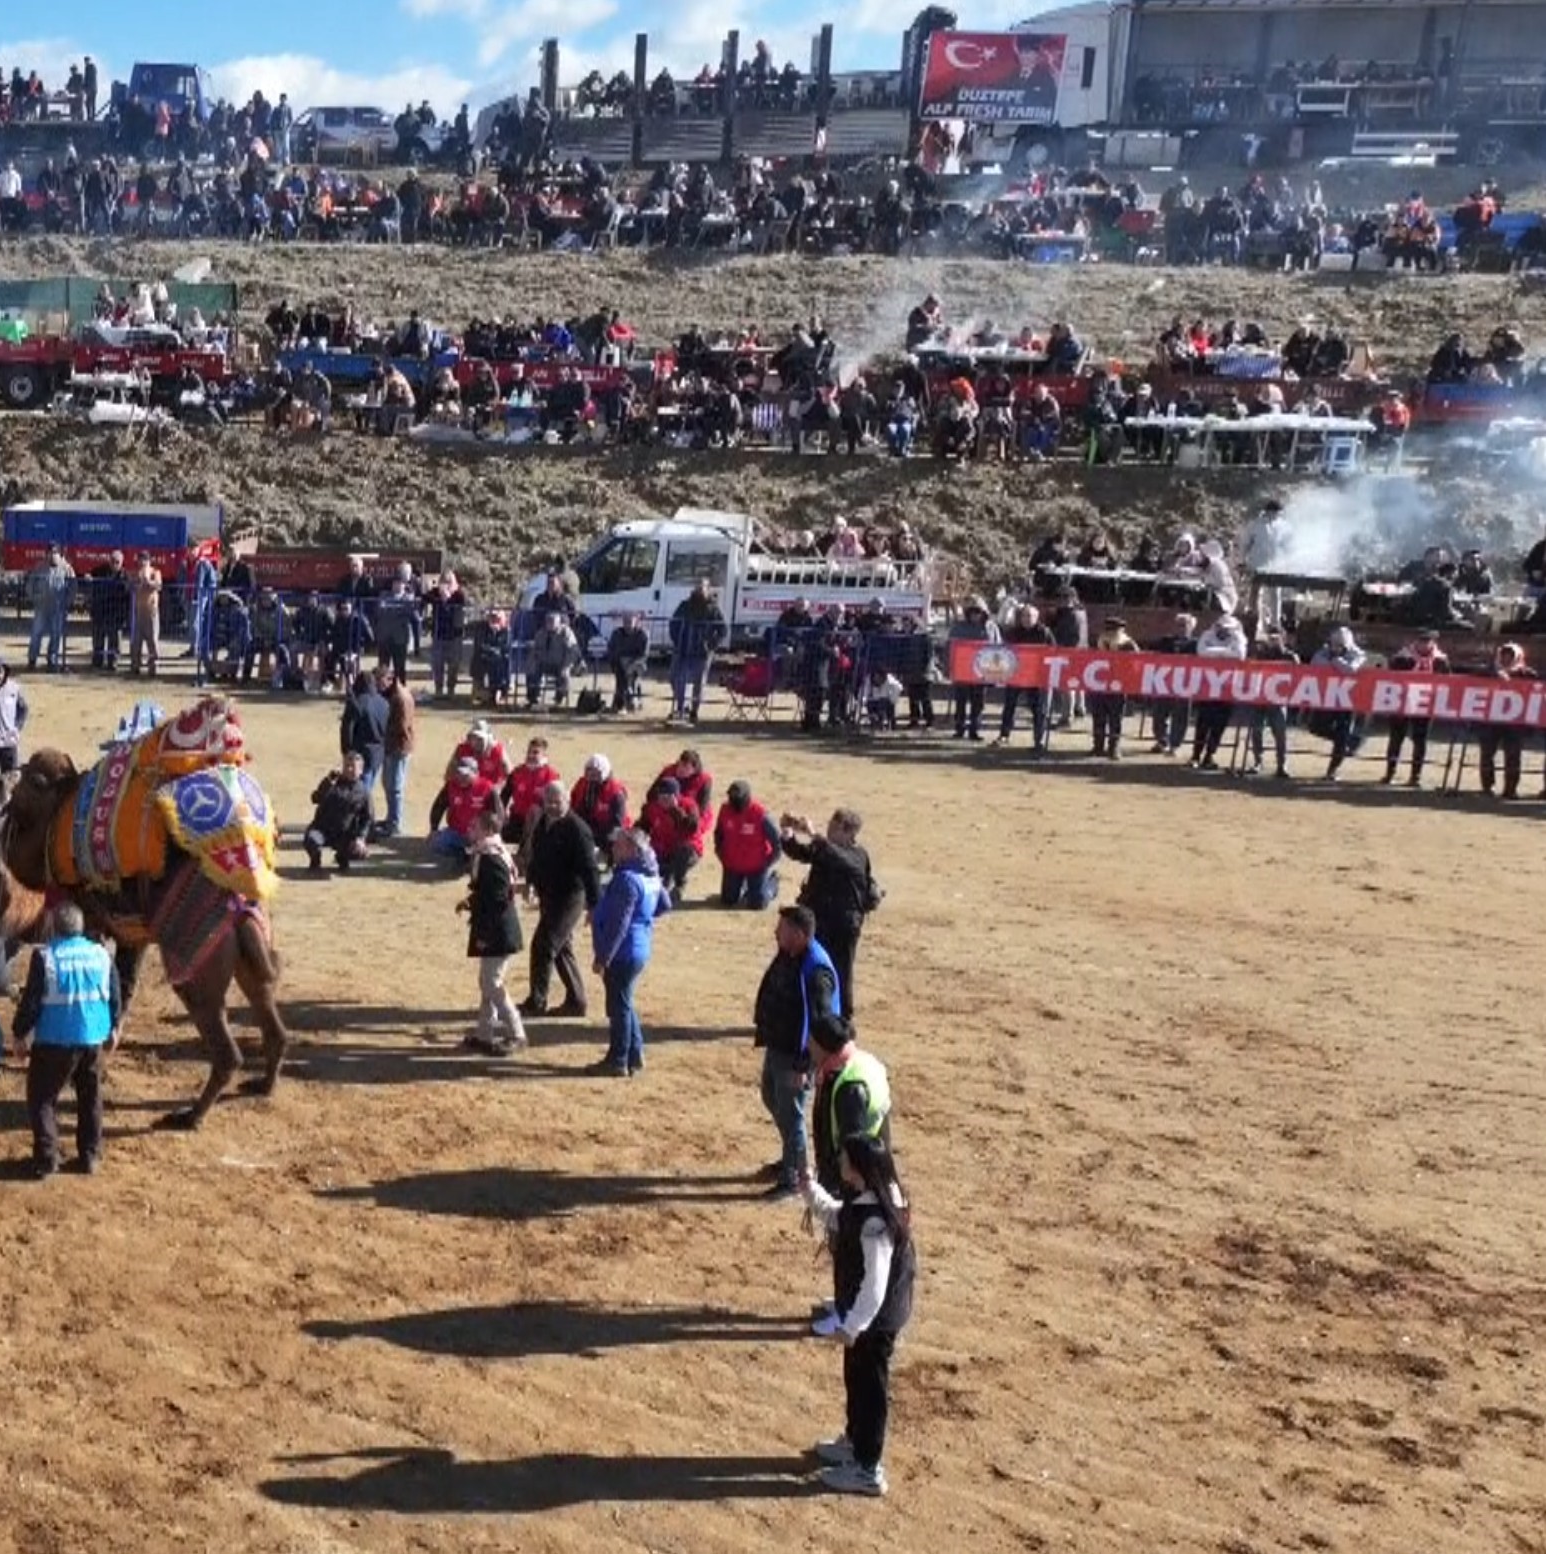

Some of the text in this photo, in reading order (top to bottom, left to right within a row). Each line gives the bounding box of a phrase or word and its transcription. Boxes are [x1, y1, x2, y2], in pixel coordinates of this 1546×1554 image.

[924, 103, 953, 115] ALP
[957, 103, 1002, 118] FRESH
[1044, 656, 1546, 725] T.C. KUYUCAK BELEDİ
